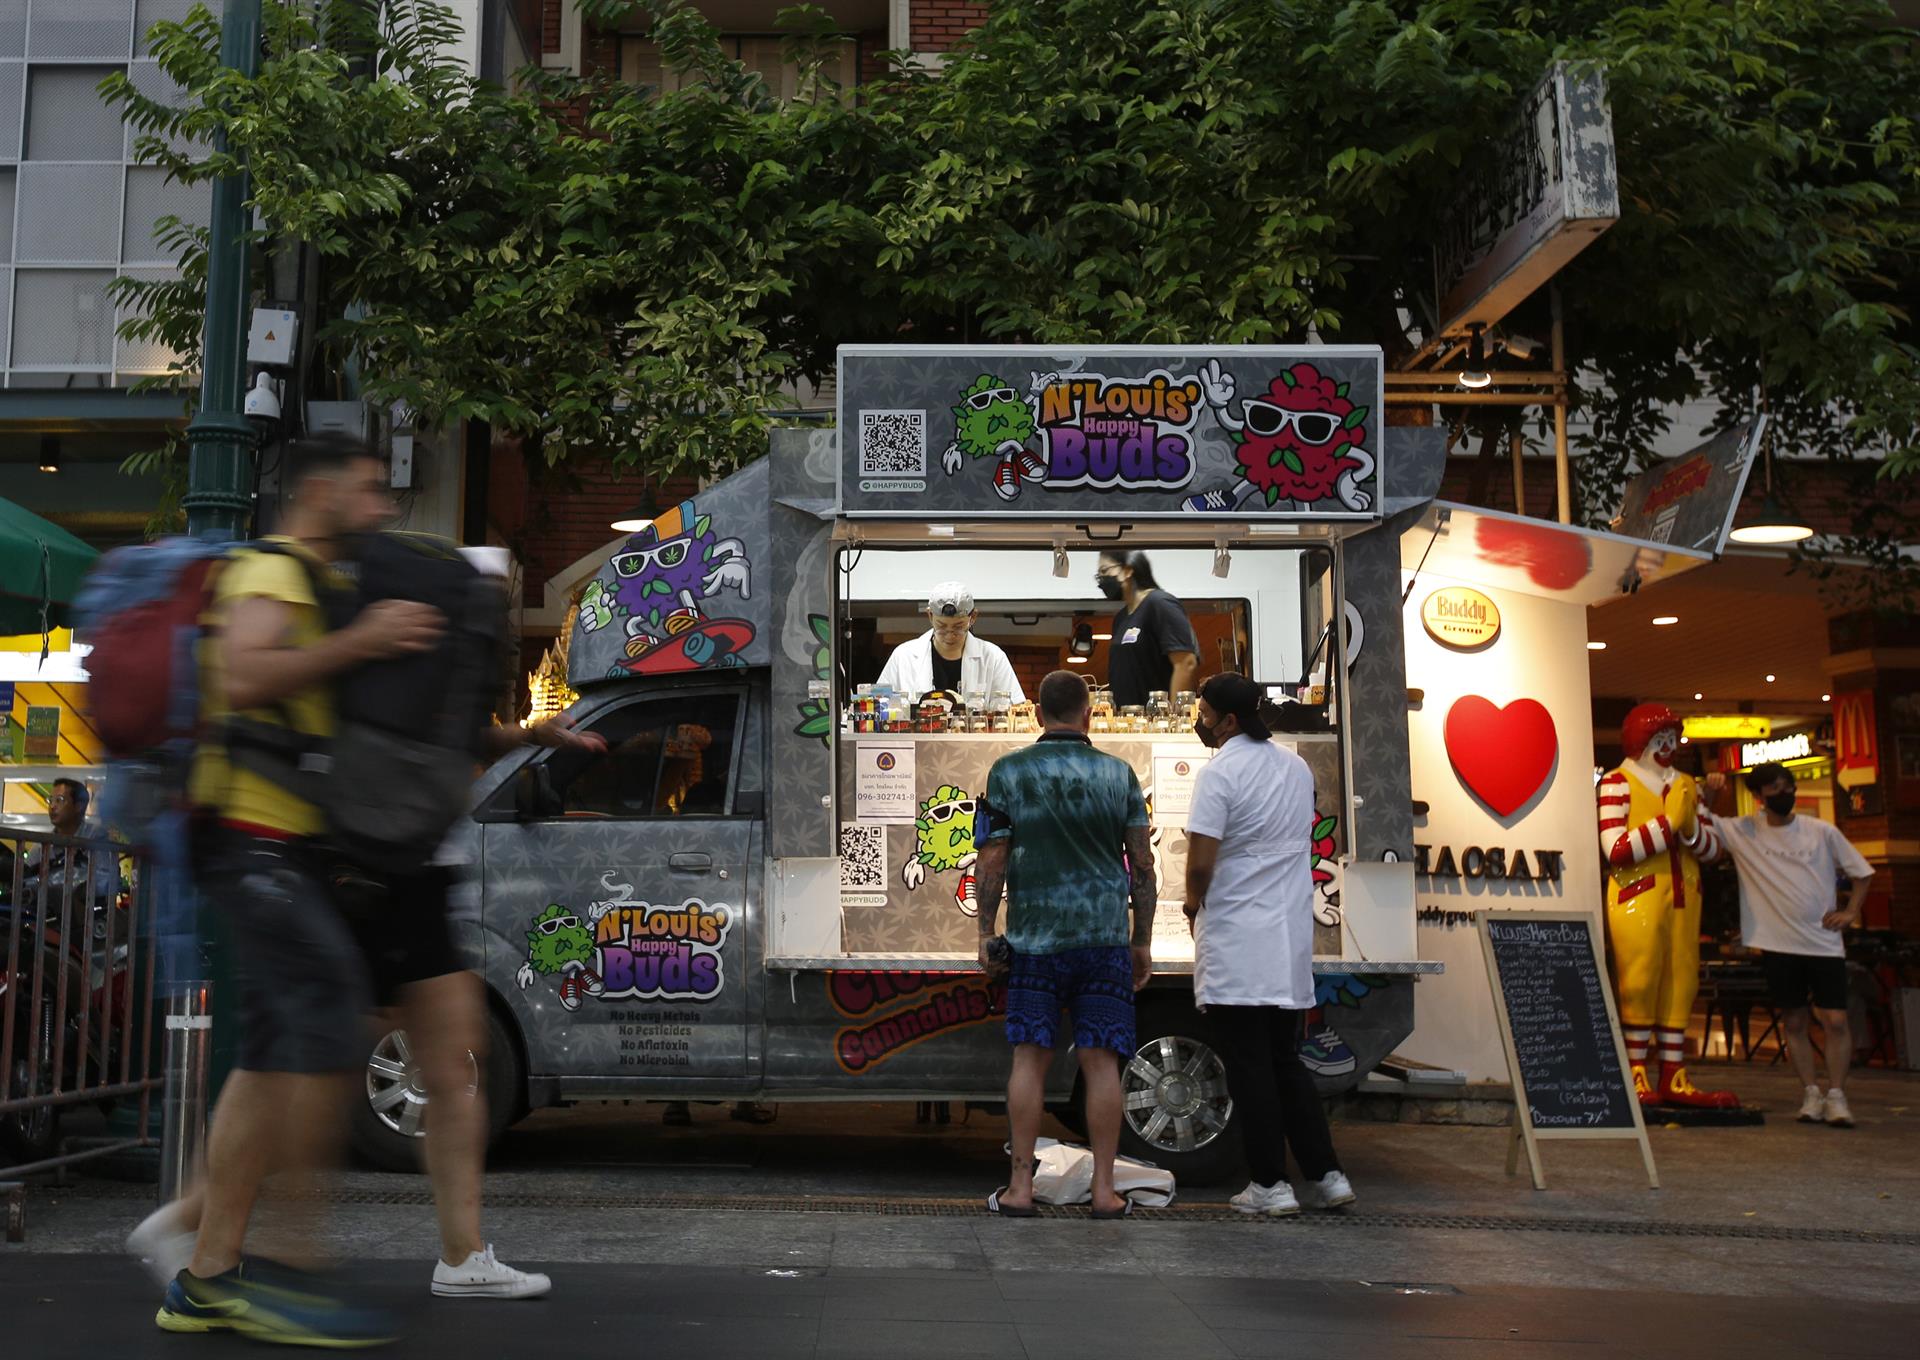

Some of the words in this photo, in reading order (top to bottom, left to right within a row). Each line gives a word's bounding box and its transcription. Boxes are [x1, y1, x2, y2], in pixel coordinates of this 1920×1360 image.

[1043, 380, 1197, 423] N'Louis'
[1084, 418, 1140, 437] Happy
[1050, 426, 1186, 479] Buds
[1437, 596, 1487, 625] Buddy
[1443, 624, 1483, 635] Group
[857, 793, 916, 801] 096-302741-8
[597, 906, 726, 944] N'Louis'
[631, 937, 678, 956] Happy
[604, 946, 716, 993] Buds
[609, 1011, 625, 1021] No
[627, 1010, 661, 1023] Heavy
[663, 1011, 701, 1022] Metals
[619, 1026, 633, 1036] No
[635, 1025, 692, 1036] Pesticides
[620, 1040, 636, 1050] No
[638, 1039, 689, 1050] Aflatoxin
[619, 1055, 634, 1065] No
[637, 1054, 689, 1065] Microbial
